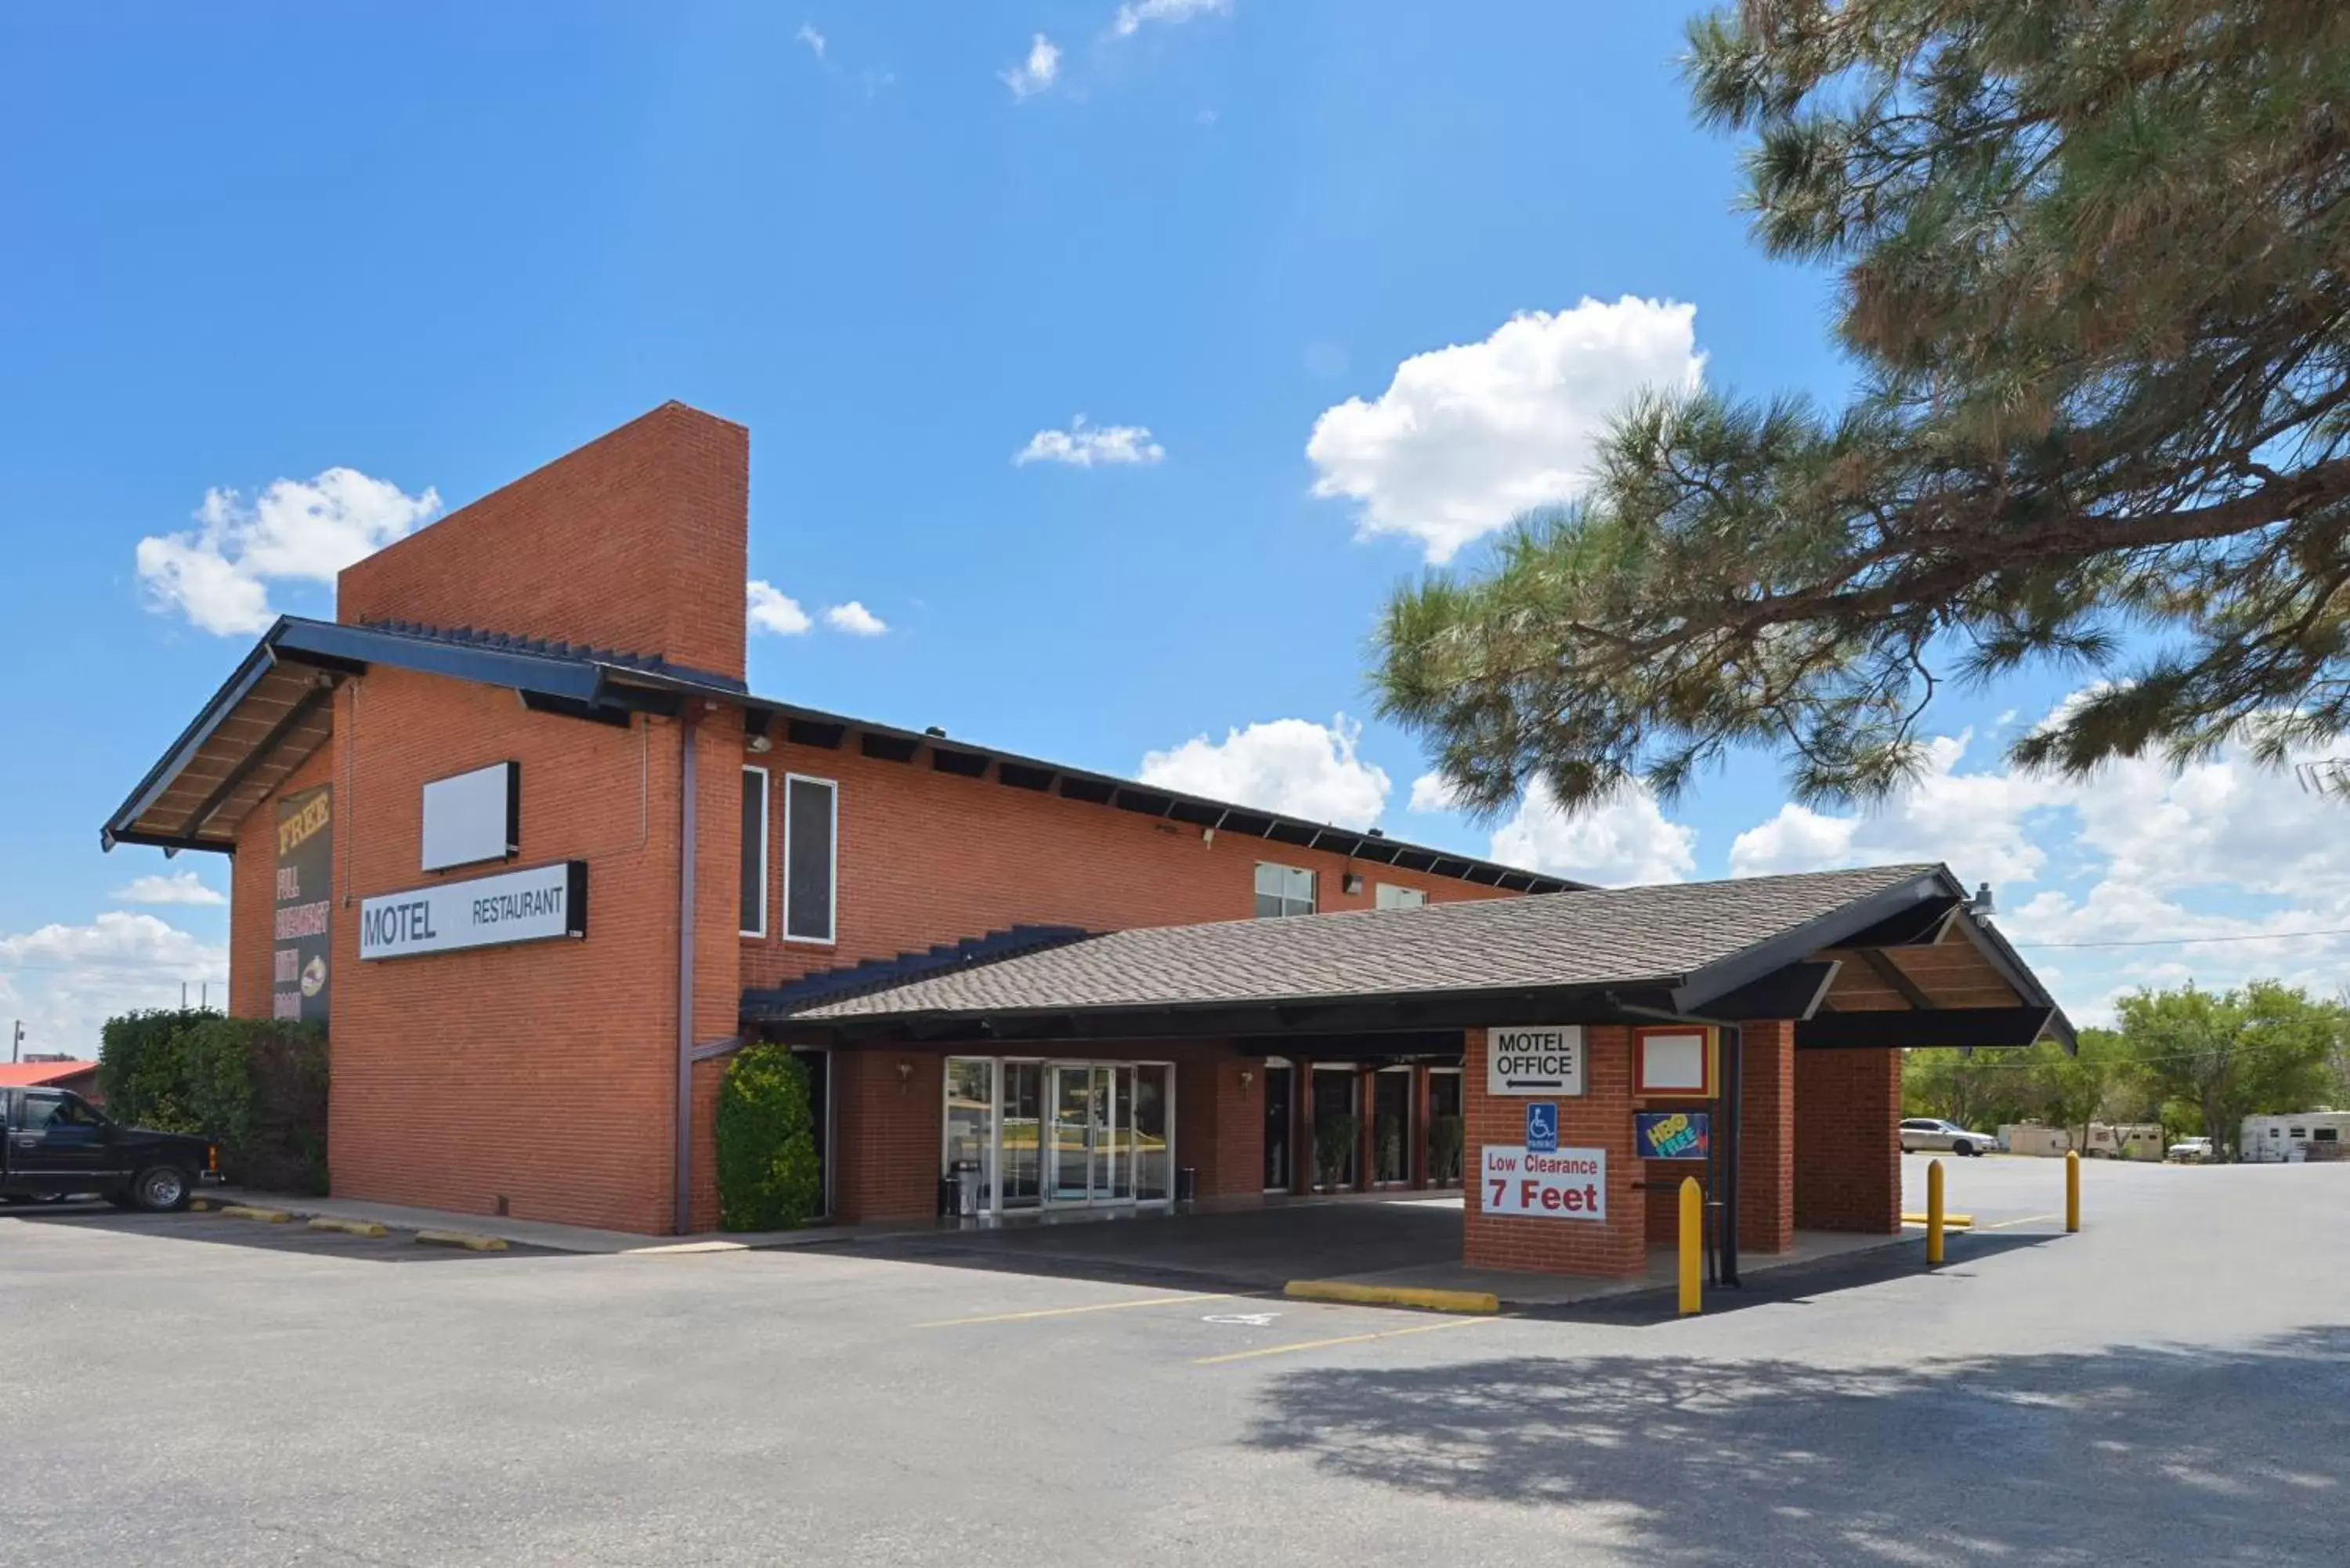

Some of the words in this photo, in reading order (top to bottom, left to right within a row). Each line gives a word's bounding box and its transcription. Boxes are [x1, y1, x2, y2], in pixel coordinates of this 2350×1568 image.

[279, 793, 329, 857] FREE
[364, 901, 436, 947] MOTEL
[473, 887, 562, 926] RESTAURANT
[1499, 1033, 1571, 1052] MOTEL
[1497, 1056, 1572, 1075] OFFICE
[1647, 1113, 1688, 1147] HBO
[1488, 1152, 1517, 1172] Low
[1524, 1154, 1598, 1174] Clearance
[1489, 1179, 1507, 1207] 7
[1520, 1179, 1598, 1212] Feet
